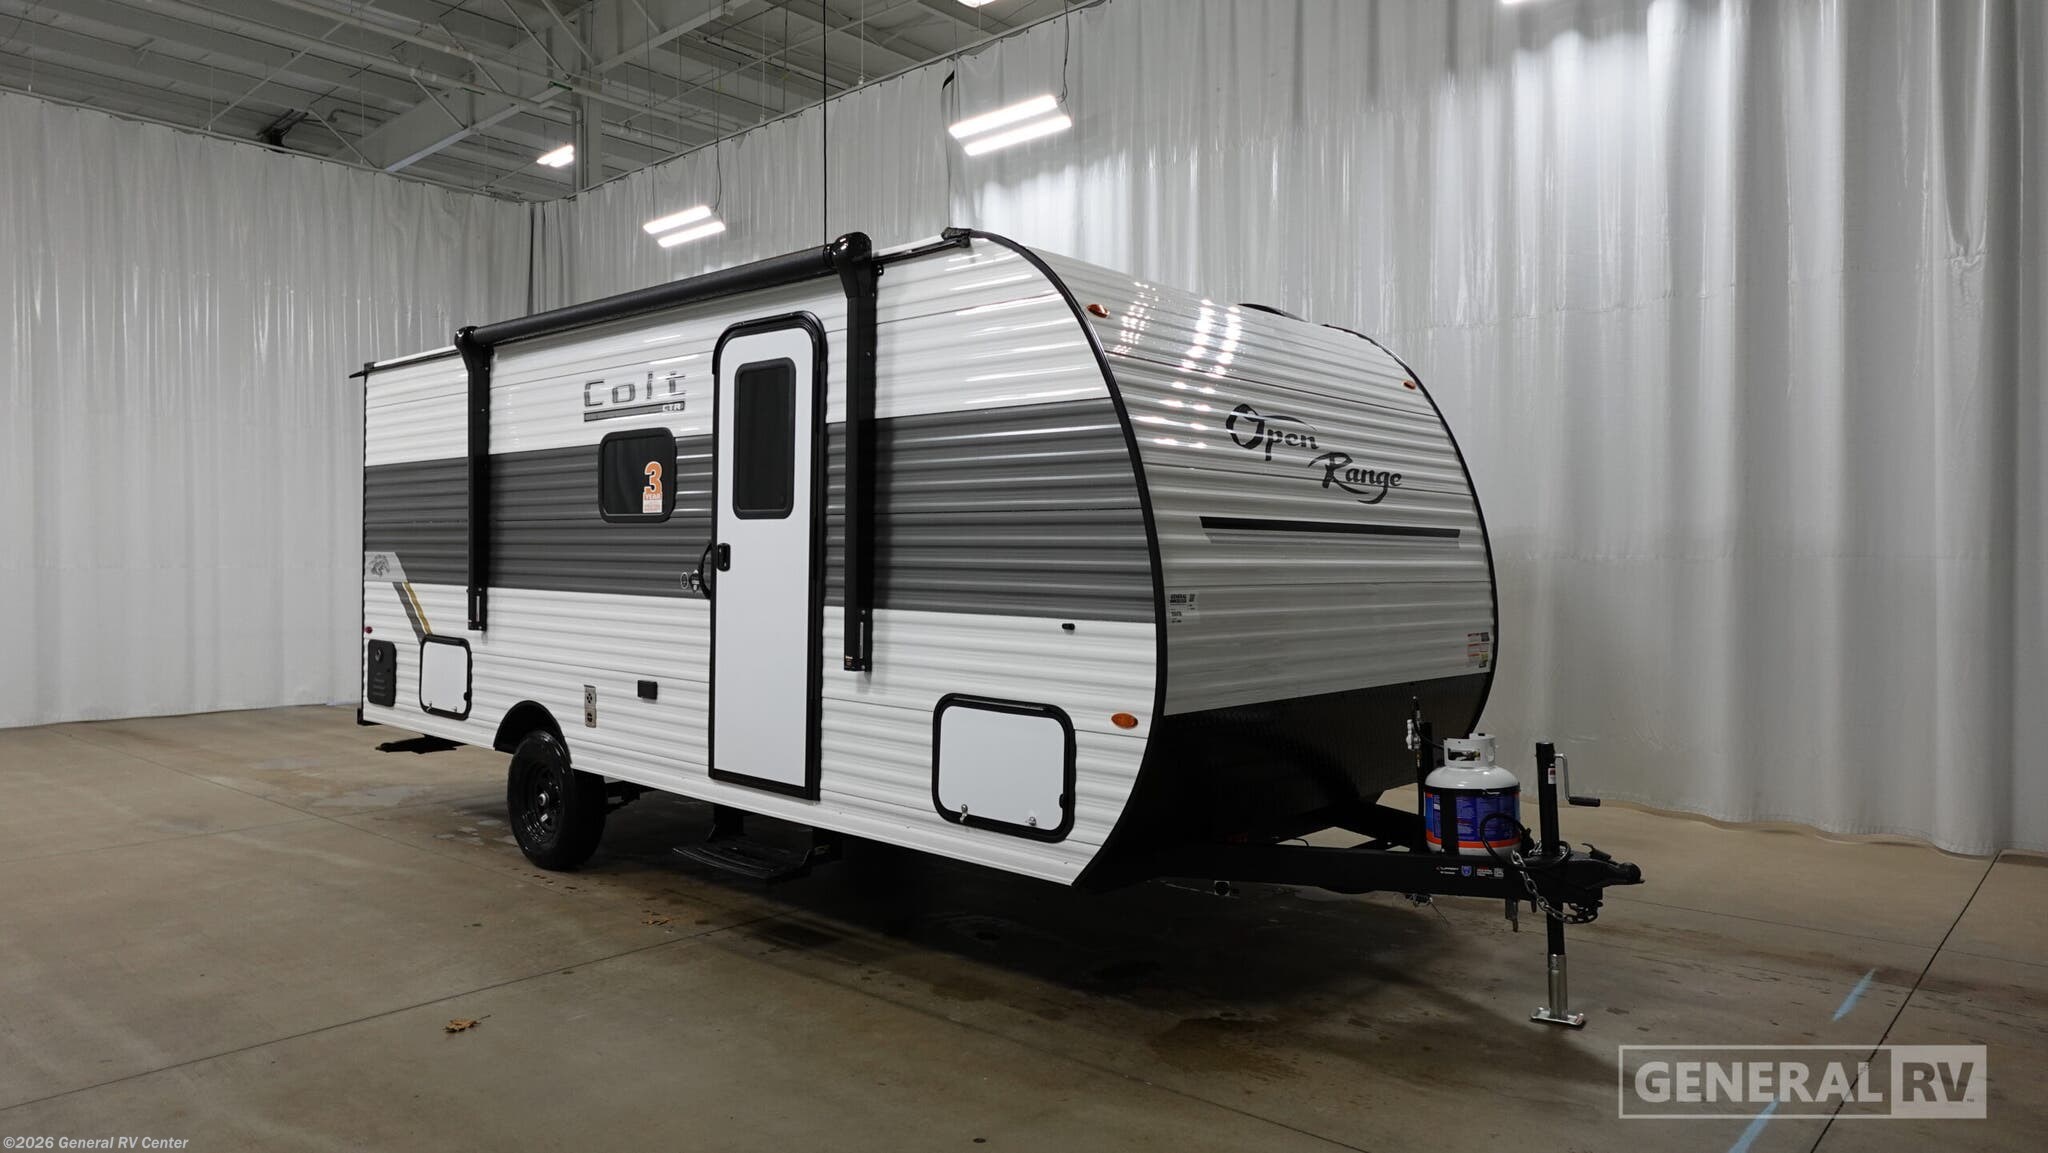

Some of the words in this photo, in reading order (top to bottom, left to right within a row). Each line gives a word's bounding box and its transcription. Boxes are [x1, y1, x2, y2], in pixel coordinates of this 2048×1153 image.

[584, 371, 686, 407] Colt
[1226, 403, 1320, 462] Open
[644, 461, 663, 495] 3
[1308, 452, 1402, 505] Range
